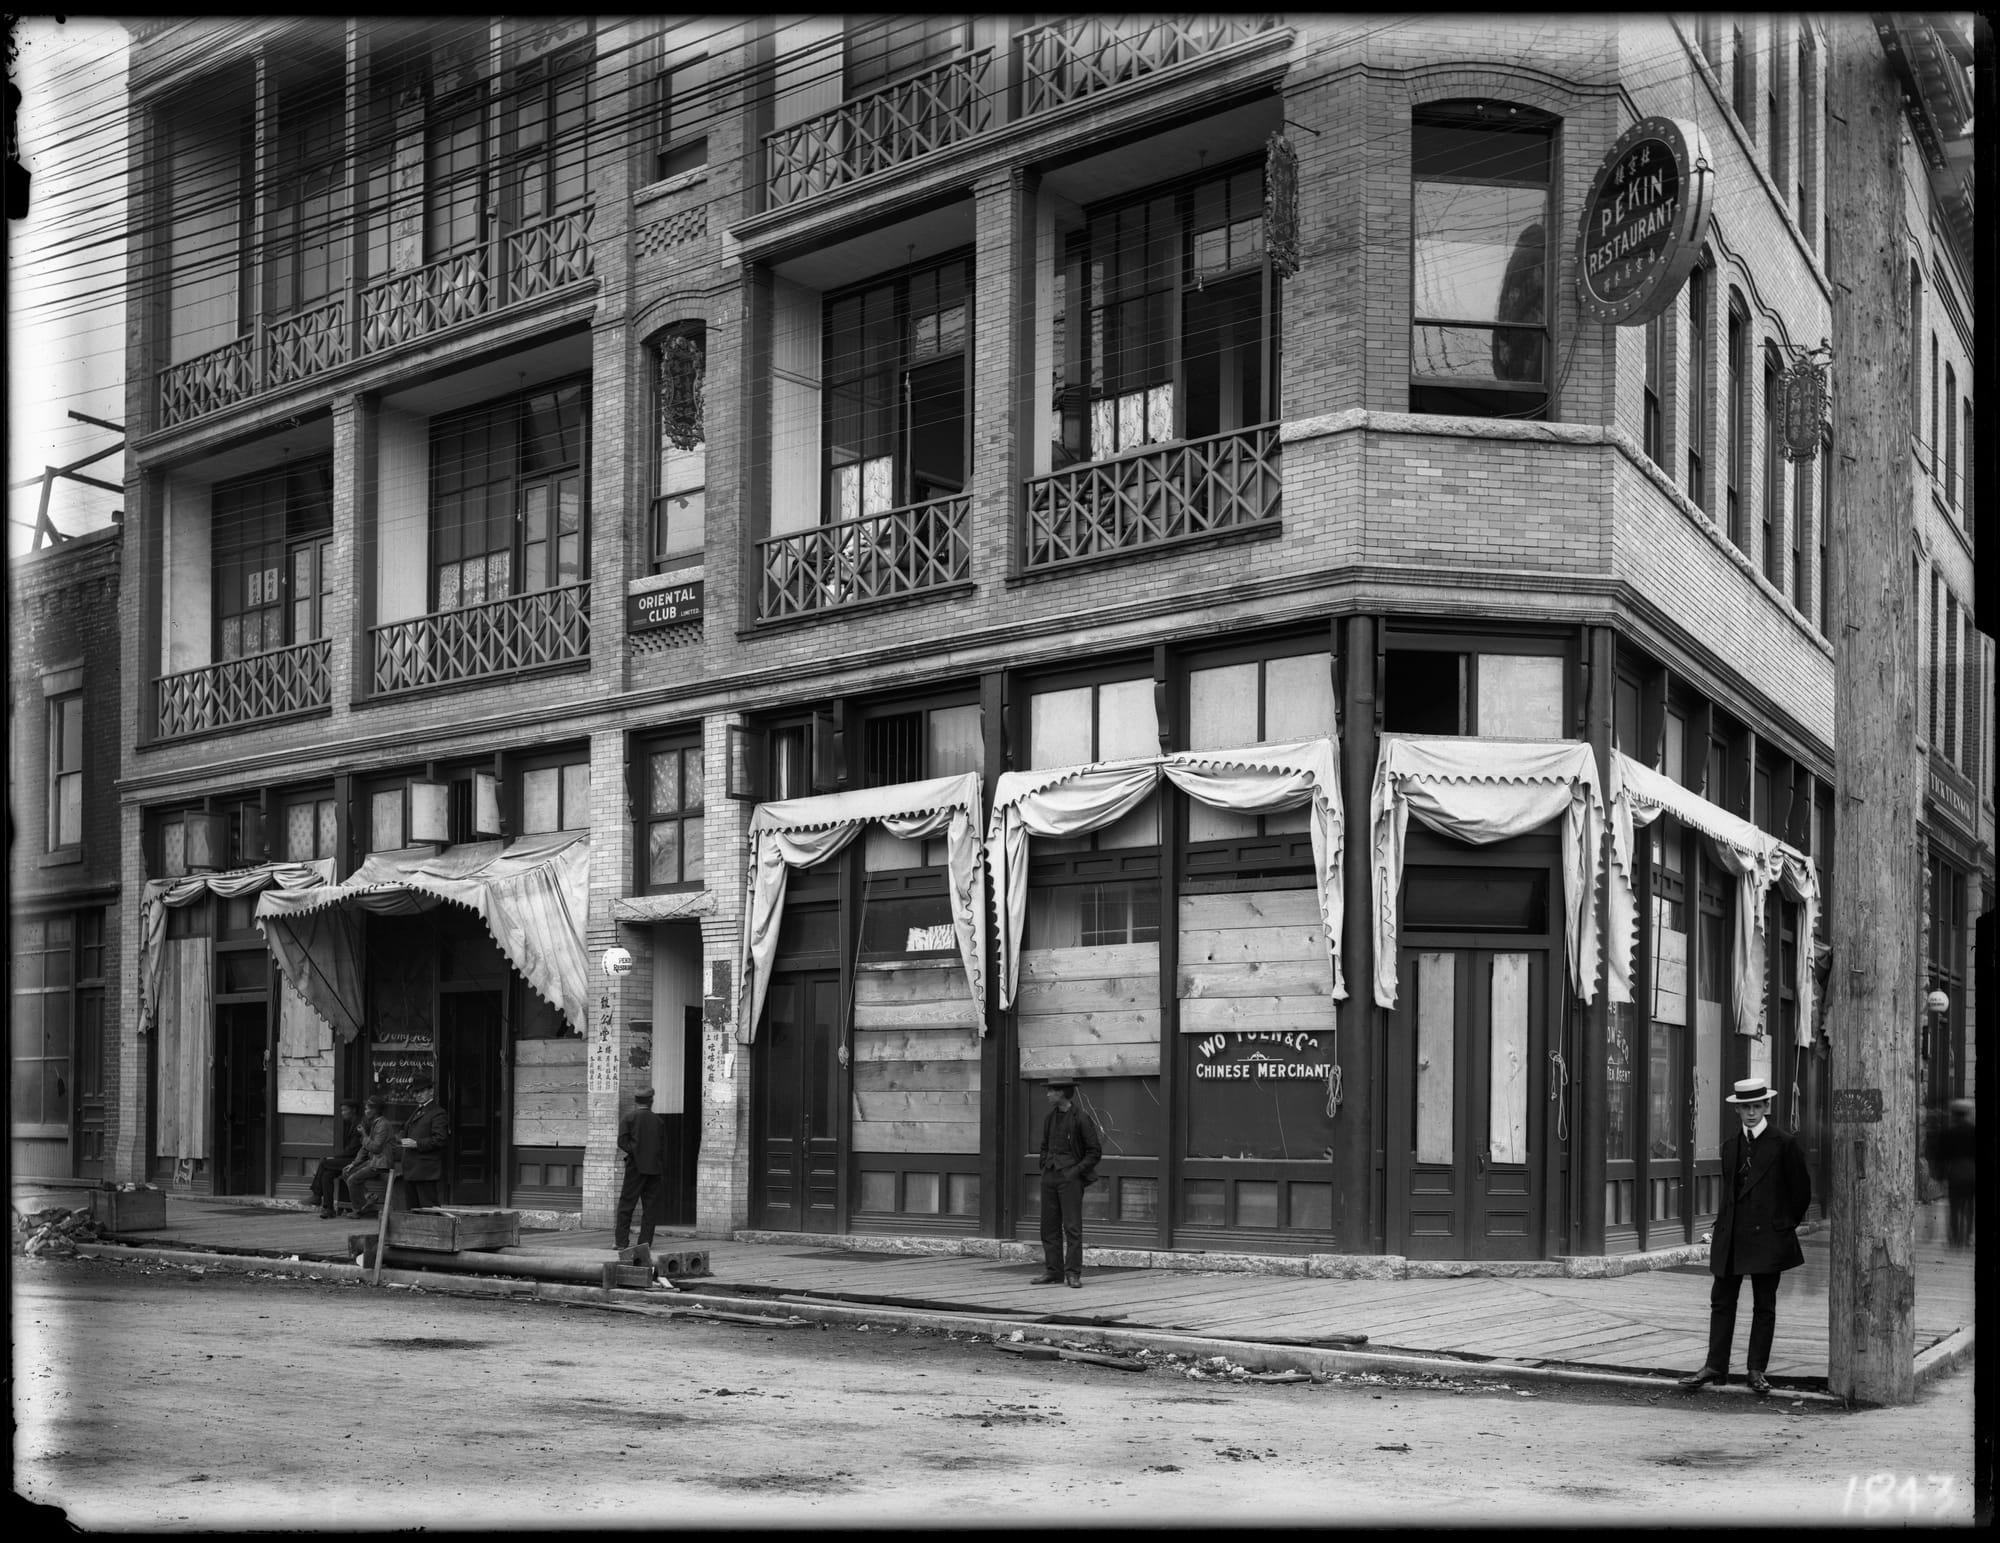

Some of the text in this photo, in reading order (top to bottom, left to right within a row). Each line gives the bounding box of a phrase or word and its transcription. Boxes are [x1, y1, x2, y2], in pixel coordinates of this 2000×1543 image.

[1601, 168, 1664, 237] PEKIN
[1589, 198, 1674, 276] RESTAURANT
[638, 587, 696, 610] ORIENTAL
[648, 606, 677, 623] CLUB
[1198, 1033, 1226, 1059] WO
[1196, 1062, 1331, 1078] CHINESE MERCHANT
